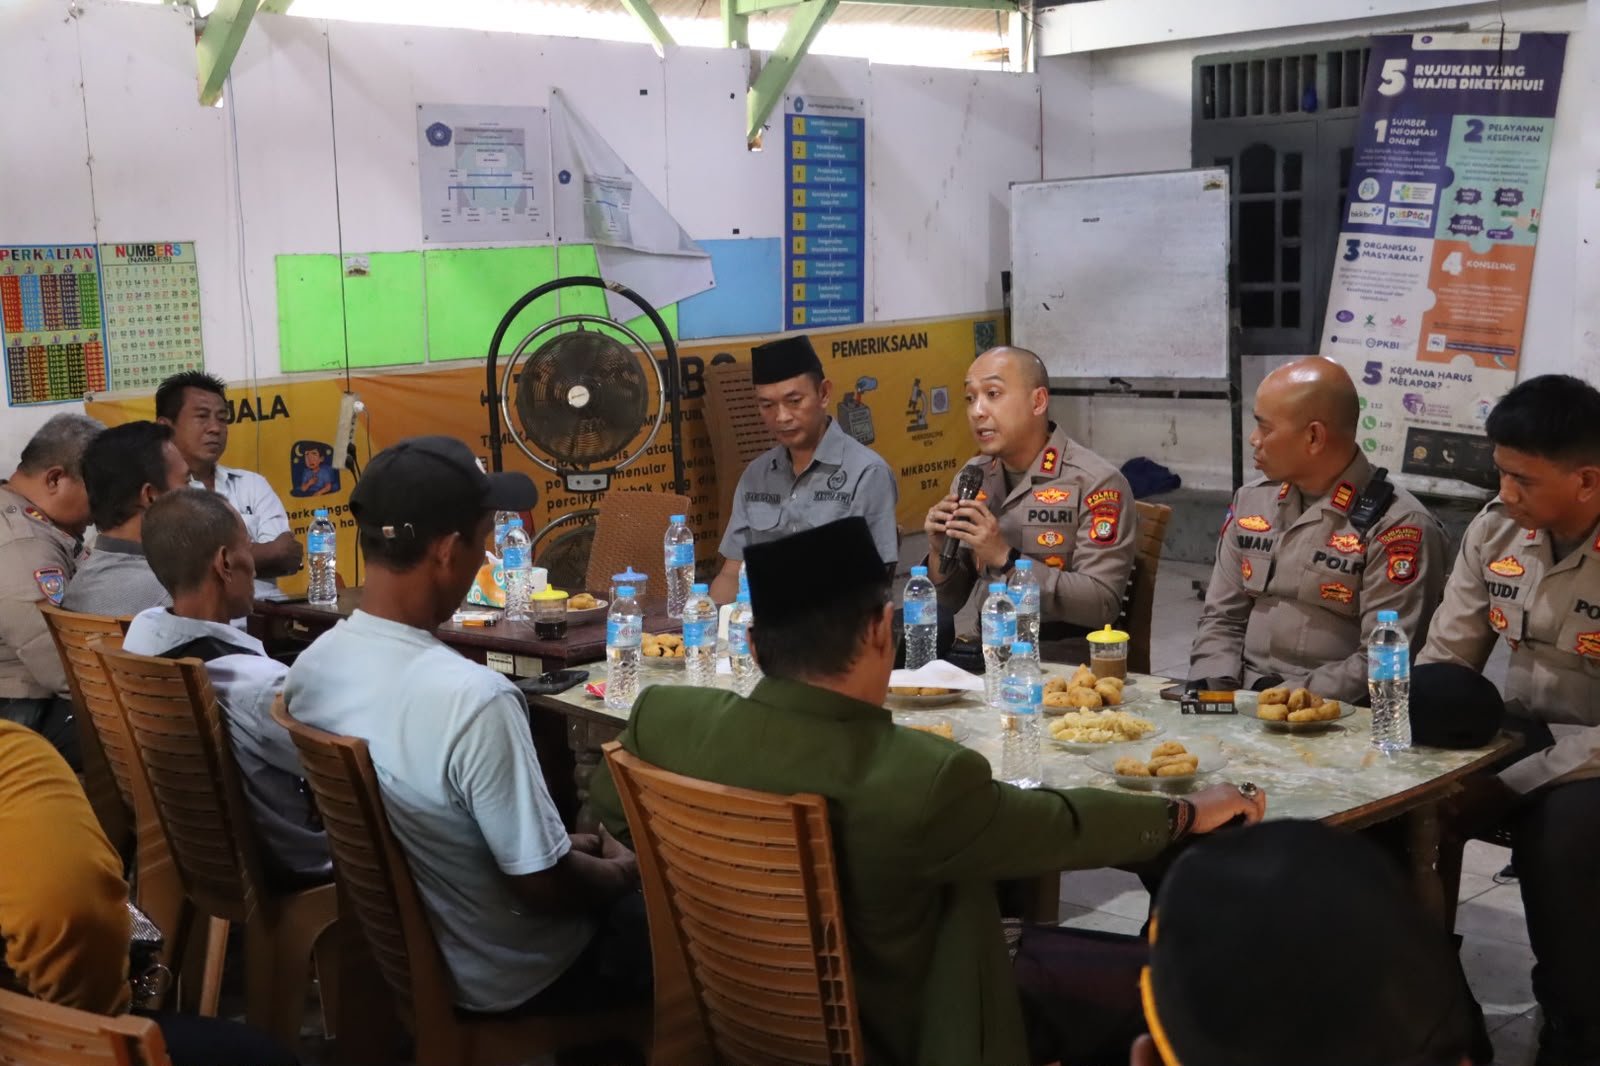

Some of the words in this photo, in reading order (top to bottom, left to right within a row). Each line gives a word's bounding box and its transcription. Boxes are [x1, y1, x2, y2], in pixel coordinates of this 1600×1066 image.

[1378, 58, 1407, 96] 5
[1414, 65, 1482, 77] RUJUKAN
[1485, 65, 1525, 77] YANG
[1413, 77, 1457, 90] WAJIB
[1459, 78, 1544, 91] DIKETAHUI!
[1392, 118, 1427, 127] SUMBER
[1488, 124, 1544, 133] PELAYANAN
[1374, 119, 1388, 143] 1
[1390, 127, 1437, 137] INFORMASI
[1463, 119, 1484, 143] 2
[1389, 137, 1420, 146] ONLINE
[1487, 134, 1541, 143] KESEHATAN
[115, 243, 182, 257] NUMBERS
[1343, 239, 1360, 262] 3
[1363, 241, 1416, 252] ORGANISASI
[0, 247, 94, 262] PERKALIAN
[1362, 251, 1424, 263] MASYARAKAT
[1441, 252, 1463, 275] 4
[1466, 260, 1516, 272] KONSELING
[832, 332, 928, 358] PEMERIKSAAN
[1376, 340, 1399, 350] PKBI
[1362, 361, 1382, 385] 5
[1390, 366, 1435, 378] KEMANA
[1438, 371, 1472, 382] HARUS
[1388, 377, 1442, 389] MELAPOR?
[226, 395, 290, 424] JALA
[613, 463, 667, 480] menular
[901, 459, 957, 477] MIKROSKPIS
[661, 479, 690, 493] yag
[921, 479, 938, 490] BTA
[1028, 509, 1072, 523] POLRI
[1312, 551, 1365, 575] POLR
